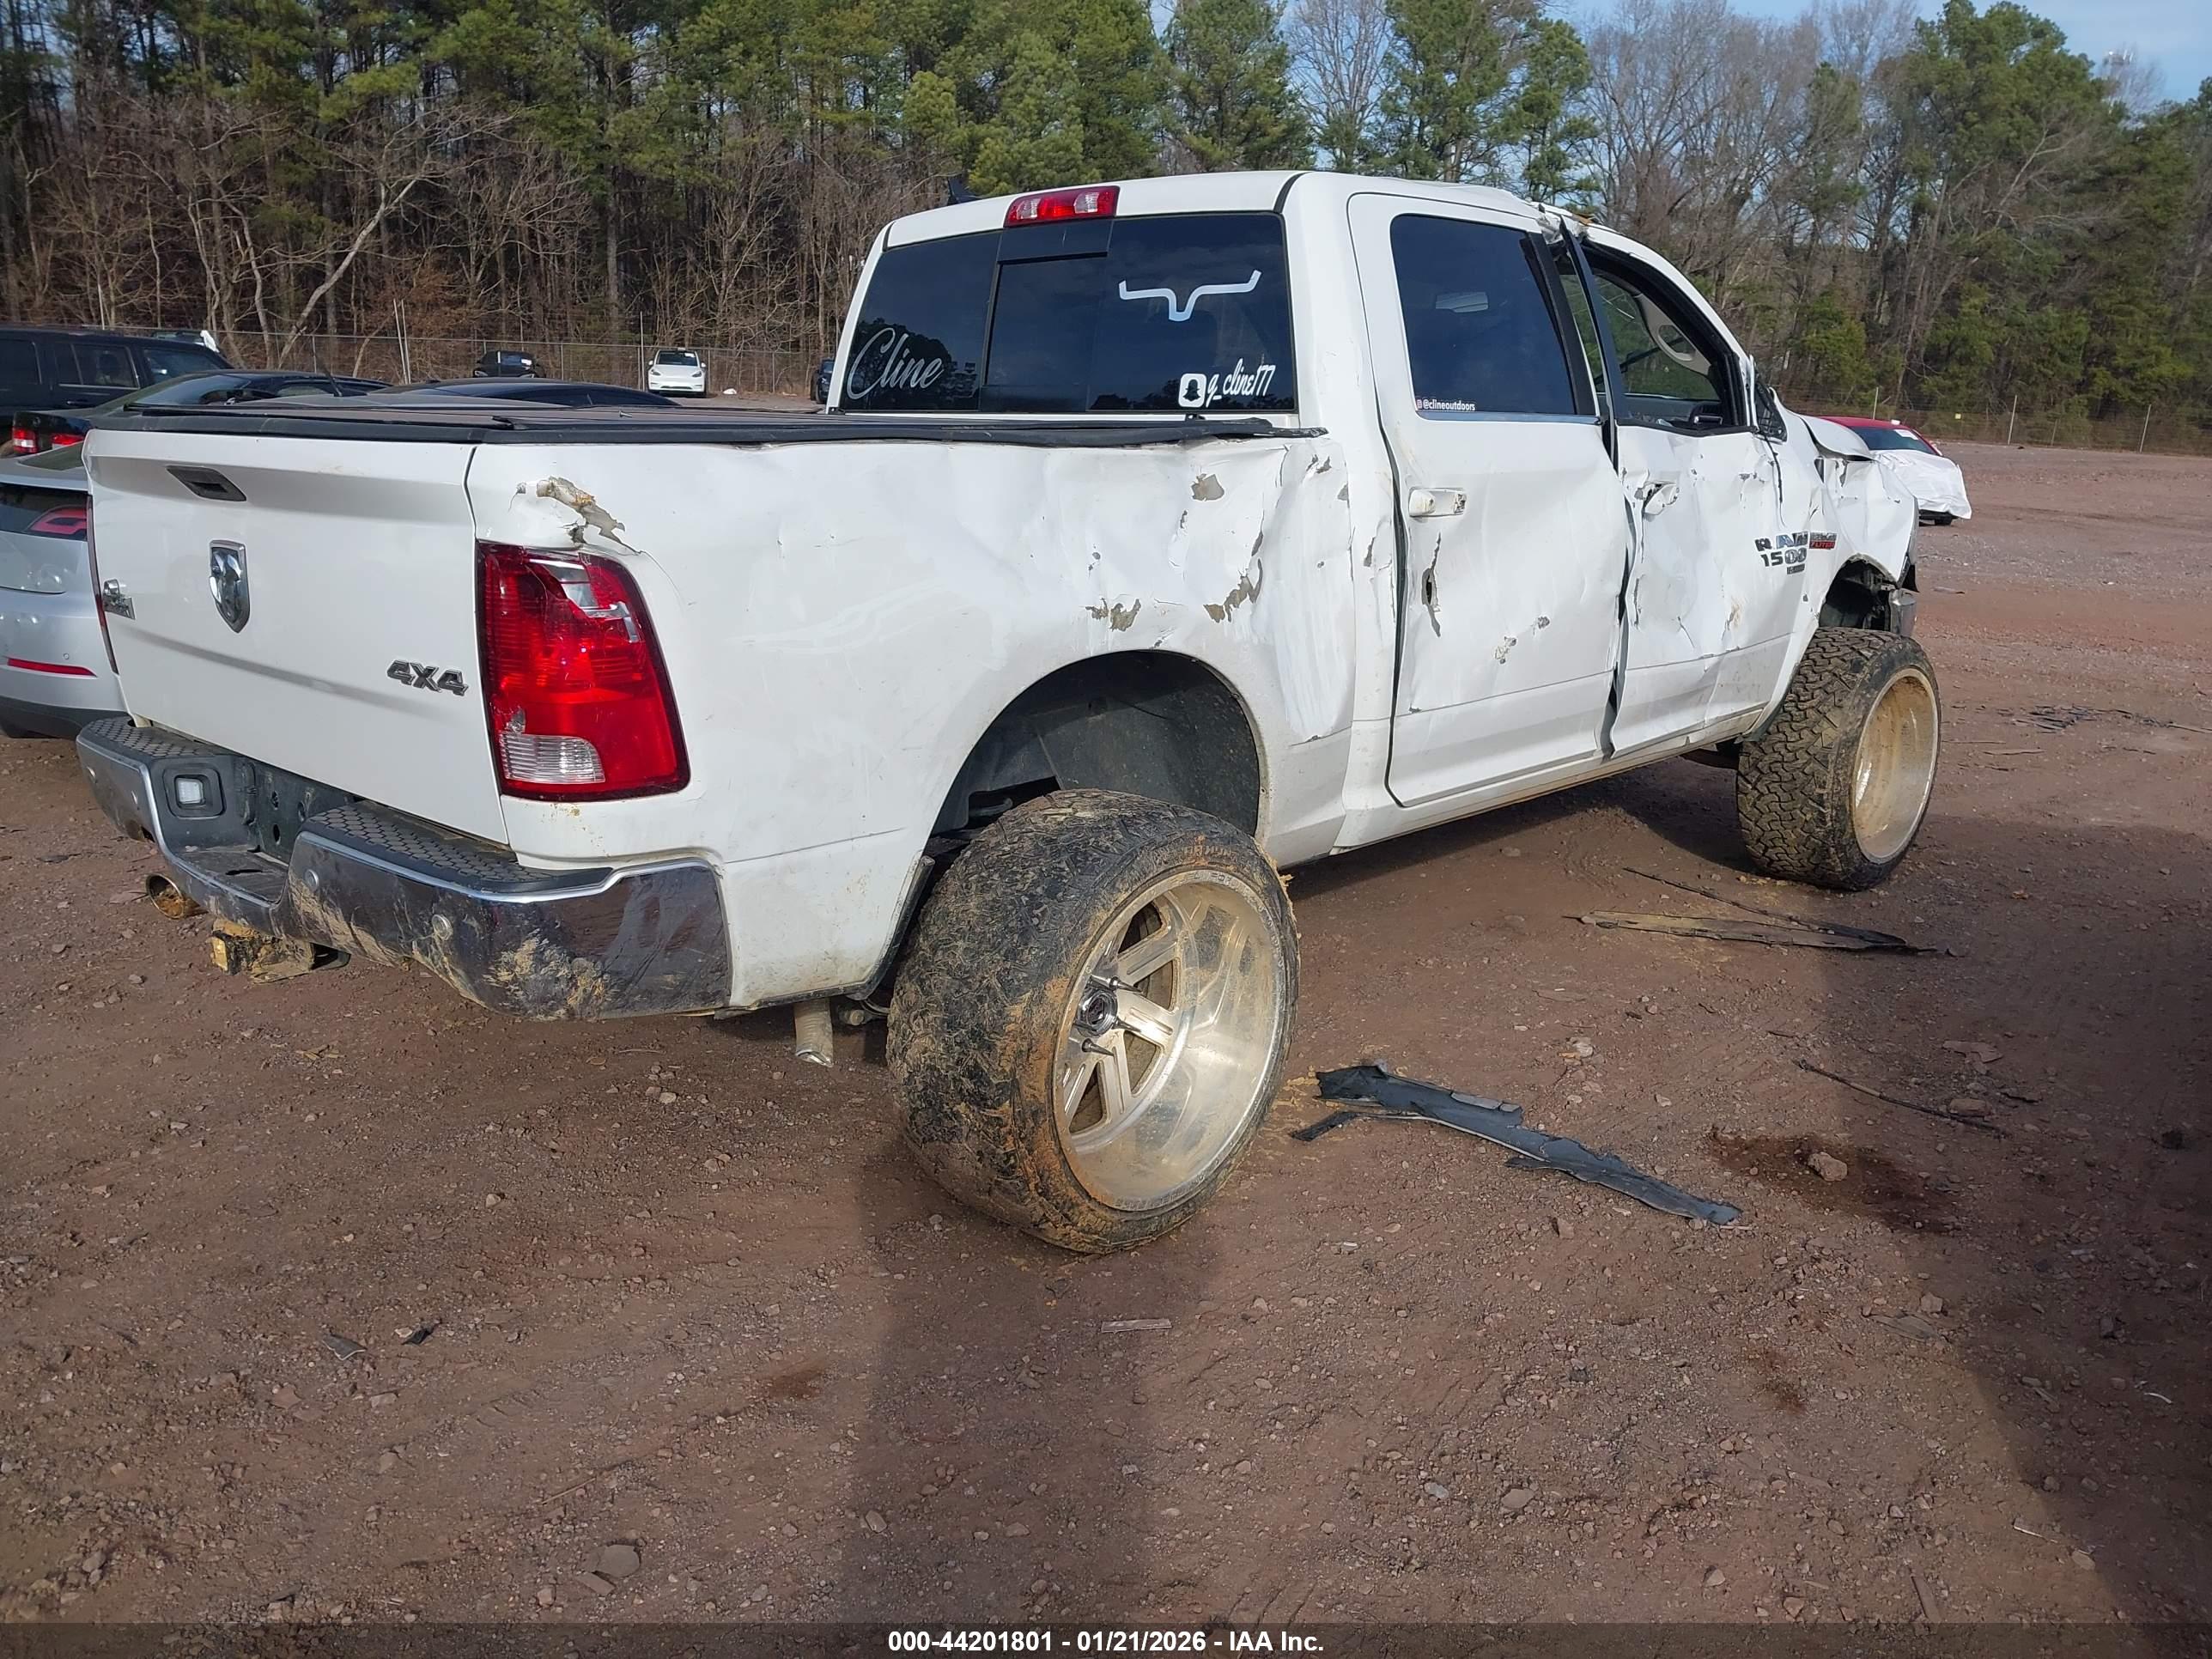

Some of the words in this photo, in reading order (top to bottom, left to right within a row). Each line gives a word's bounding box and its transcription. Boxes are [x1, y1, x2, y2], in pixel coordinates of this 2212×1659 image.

[847, 327, 945, 400] Cline
[1423, 398, 1476, 411] @clineoutdoors
[1759, 547, 1808, 568] 1500
